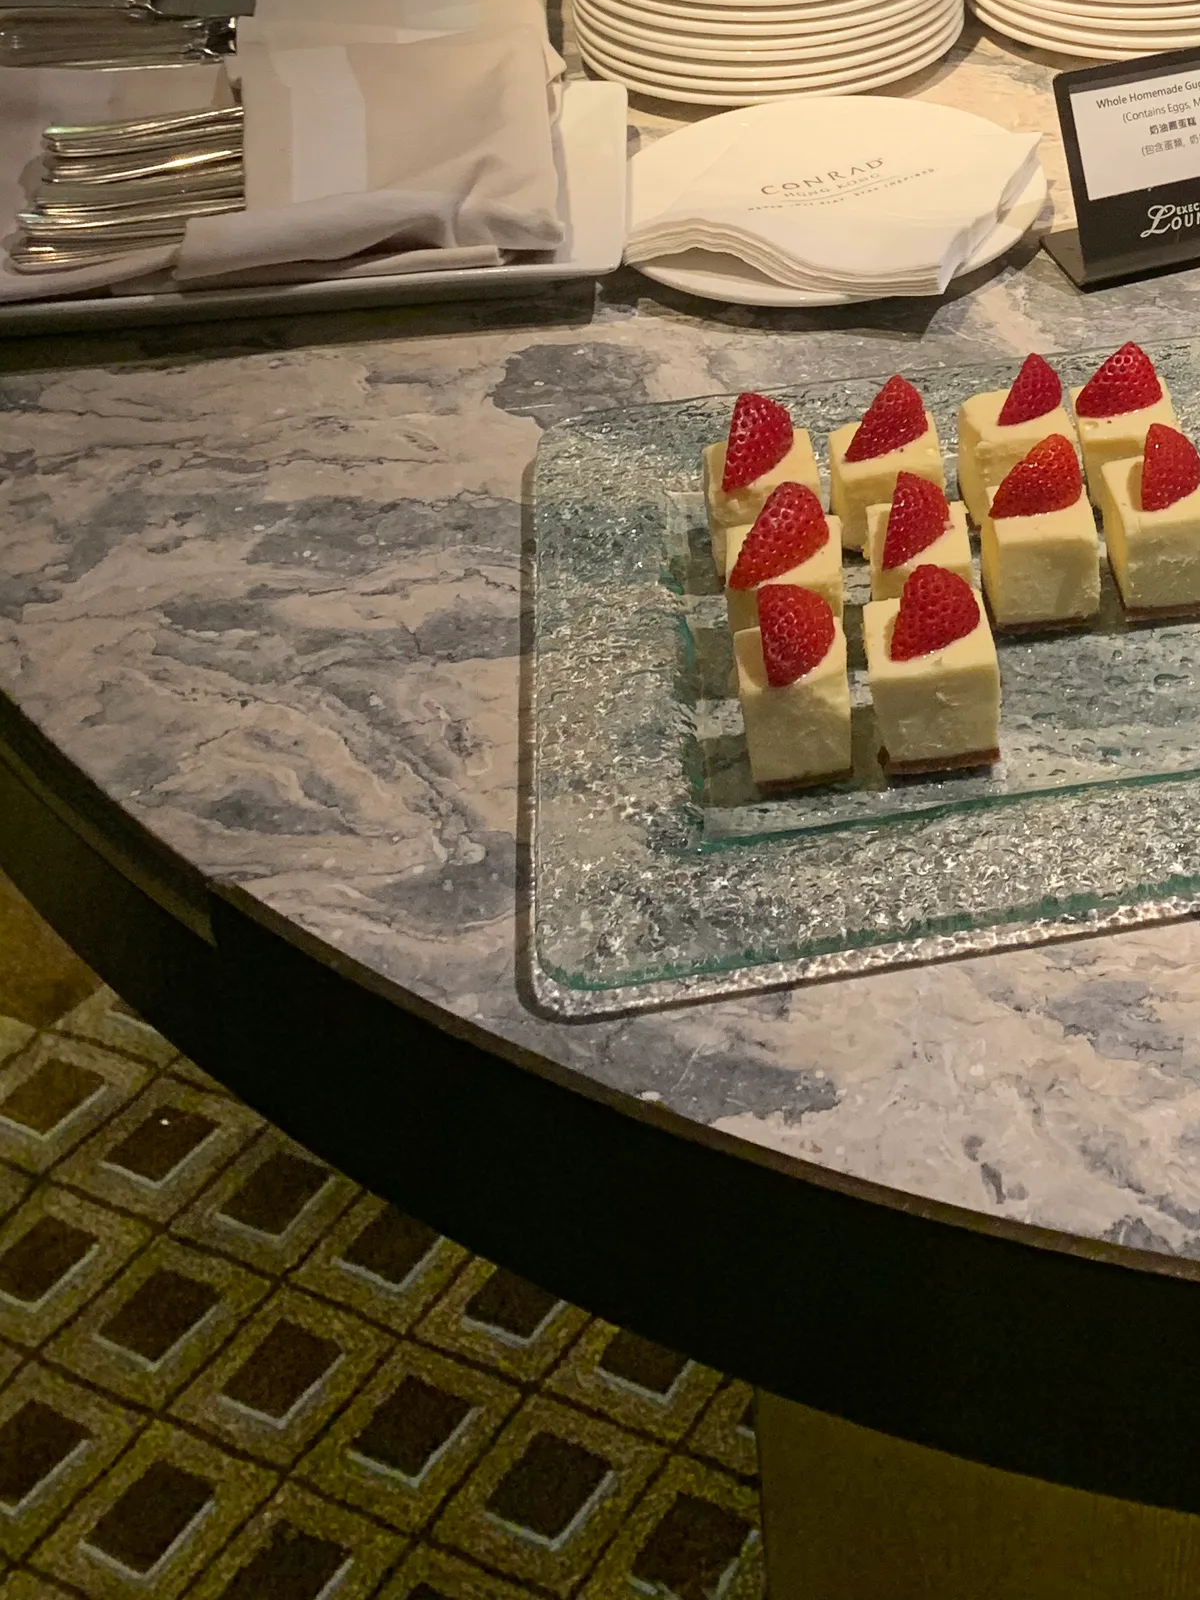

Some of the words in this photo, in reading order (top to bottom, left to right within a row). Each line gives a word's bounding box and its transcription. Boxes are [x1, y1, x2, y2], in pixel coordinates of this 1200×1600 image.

[1095, 93, 1128, 109] Whole
[1128, 83, 1184, 103] Homemade
[1122, 106, 1166, 123] (Contains
[1167, 100, 1192, 113] Eggs,
[760, 158, 883, 196] CONRAD
